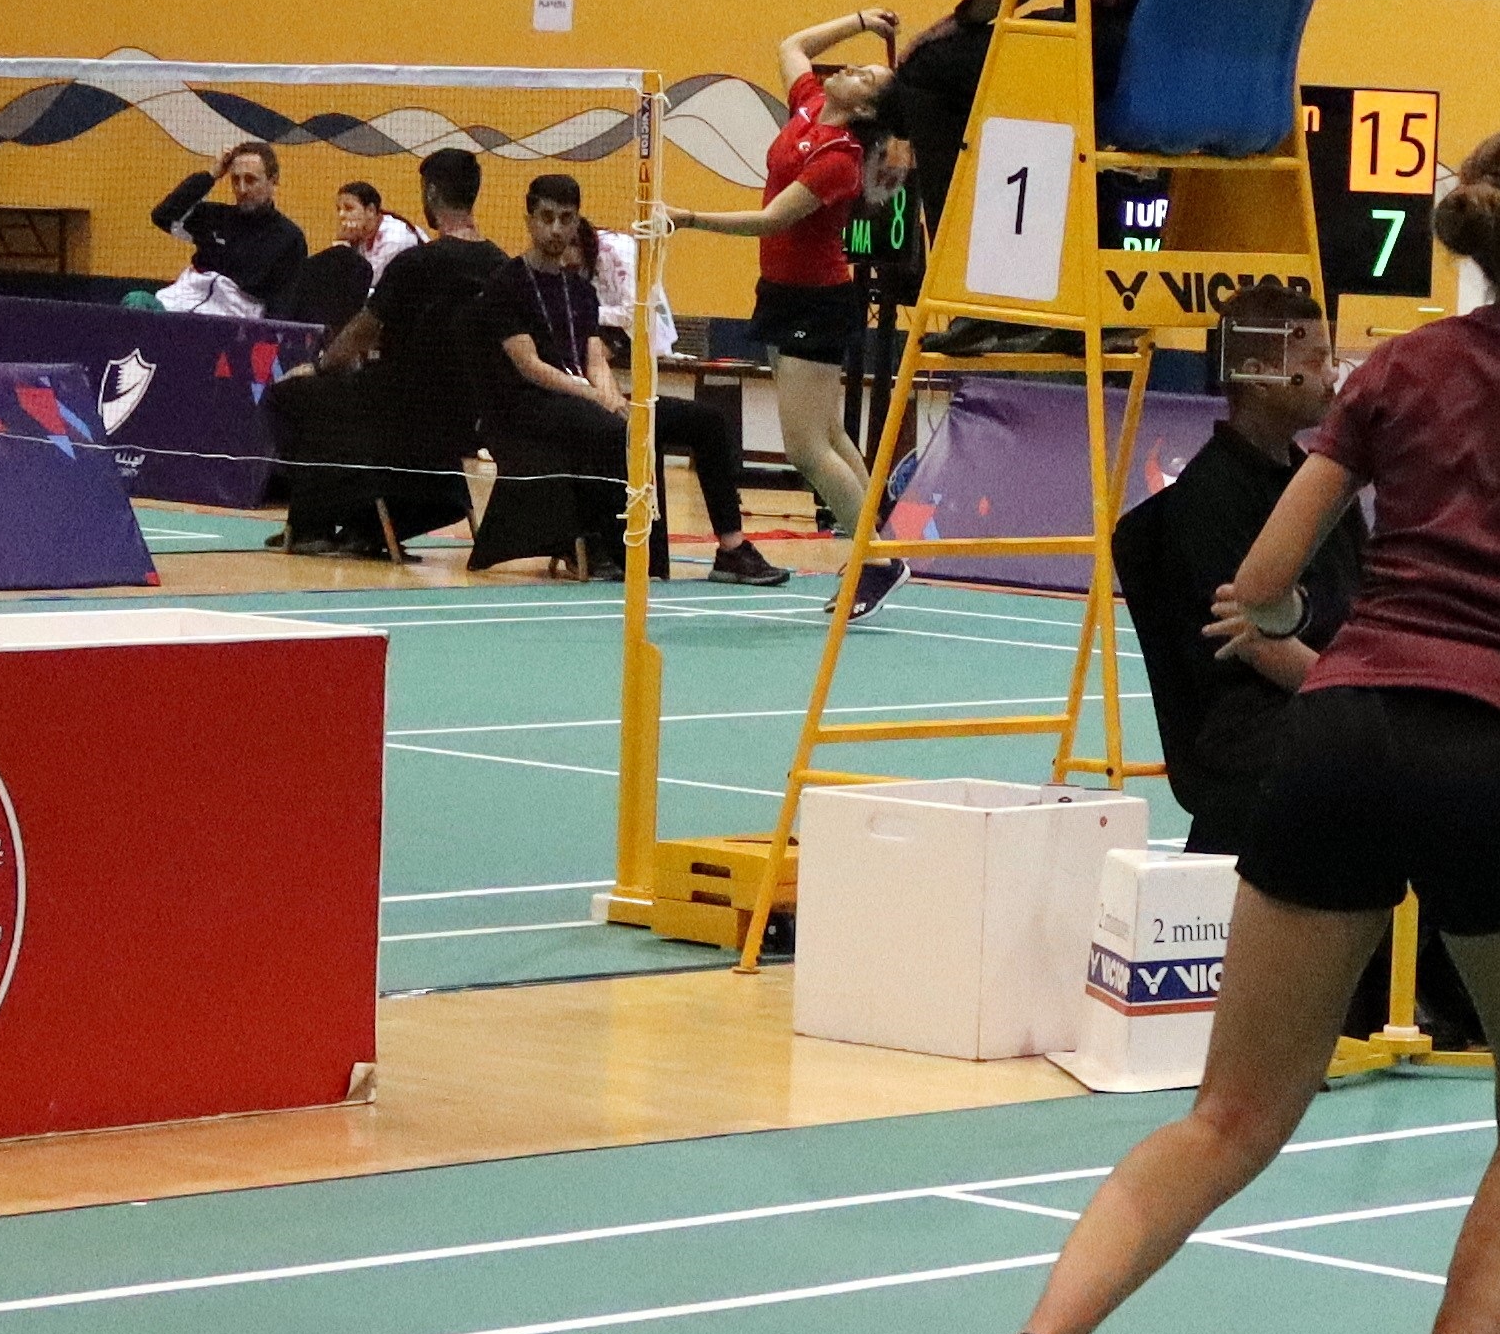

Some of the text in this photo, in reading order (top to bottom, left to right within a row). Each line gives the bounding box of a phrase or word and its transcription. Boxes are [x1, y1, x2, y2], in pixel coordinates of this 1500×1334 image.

[1360, 110, 1429, 178] 15
[1005, 165, 1031, 237] 1
[1372, 209, 1406, 277] 7
[1153, 917, 1165, 944] 2
